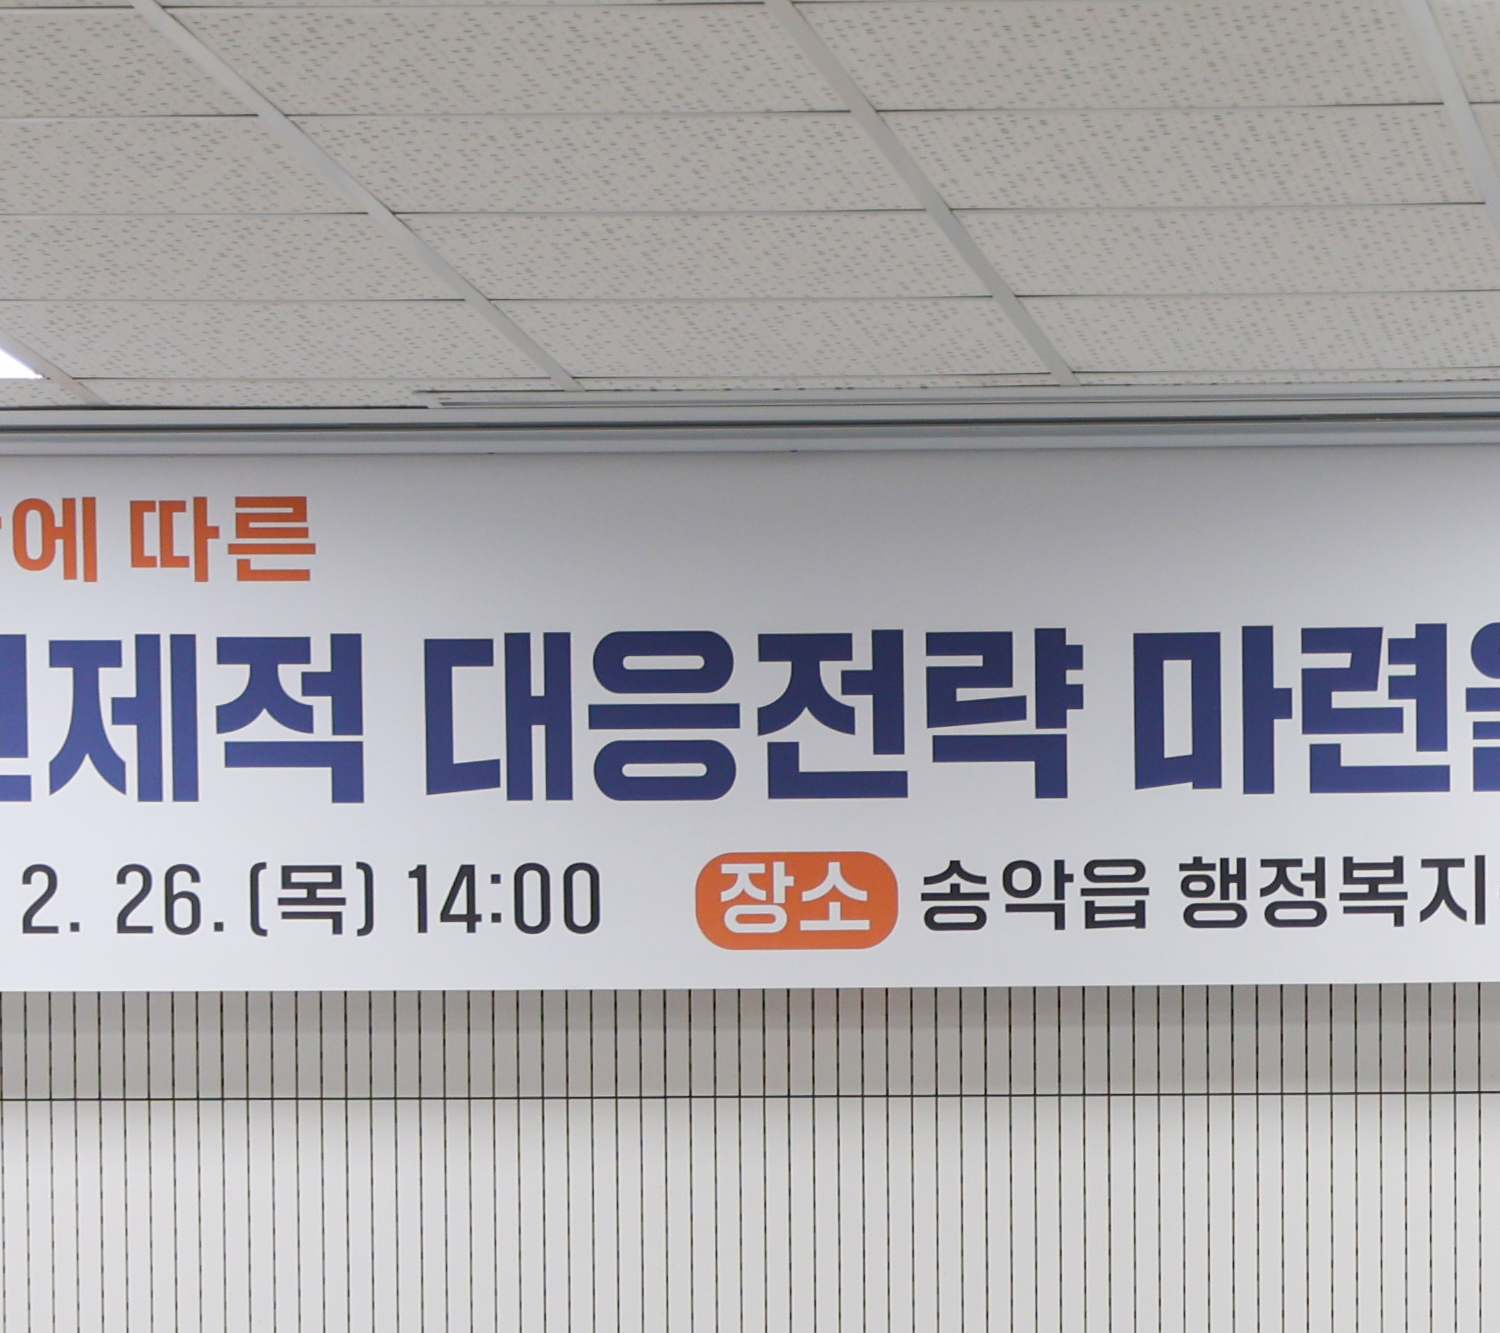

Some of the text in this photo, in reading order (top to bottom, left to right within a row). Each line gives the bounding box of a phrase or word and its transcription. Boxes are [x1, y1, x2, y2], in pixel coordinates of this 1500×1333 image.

[130, 496, 317, 584] 따른
[425, 628, 1084, 801] 대응전략
[22, 864, 81, 935] 2.
[407, 862, 601, 936] 14:00
[720, 859, 872, 932] 장소
[920, 858, 1151, 932] 송악읍
